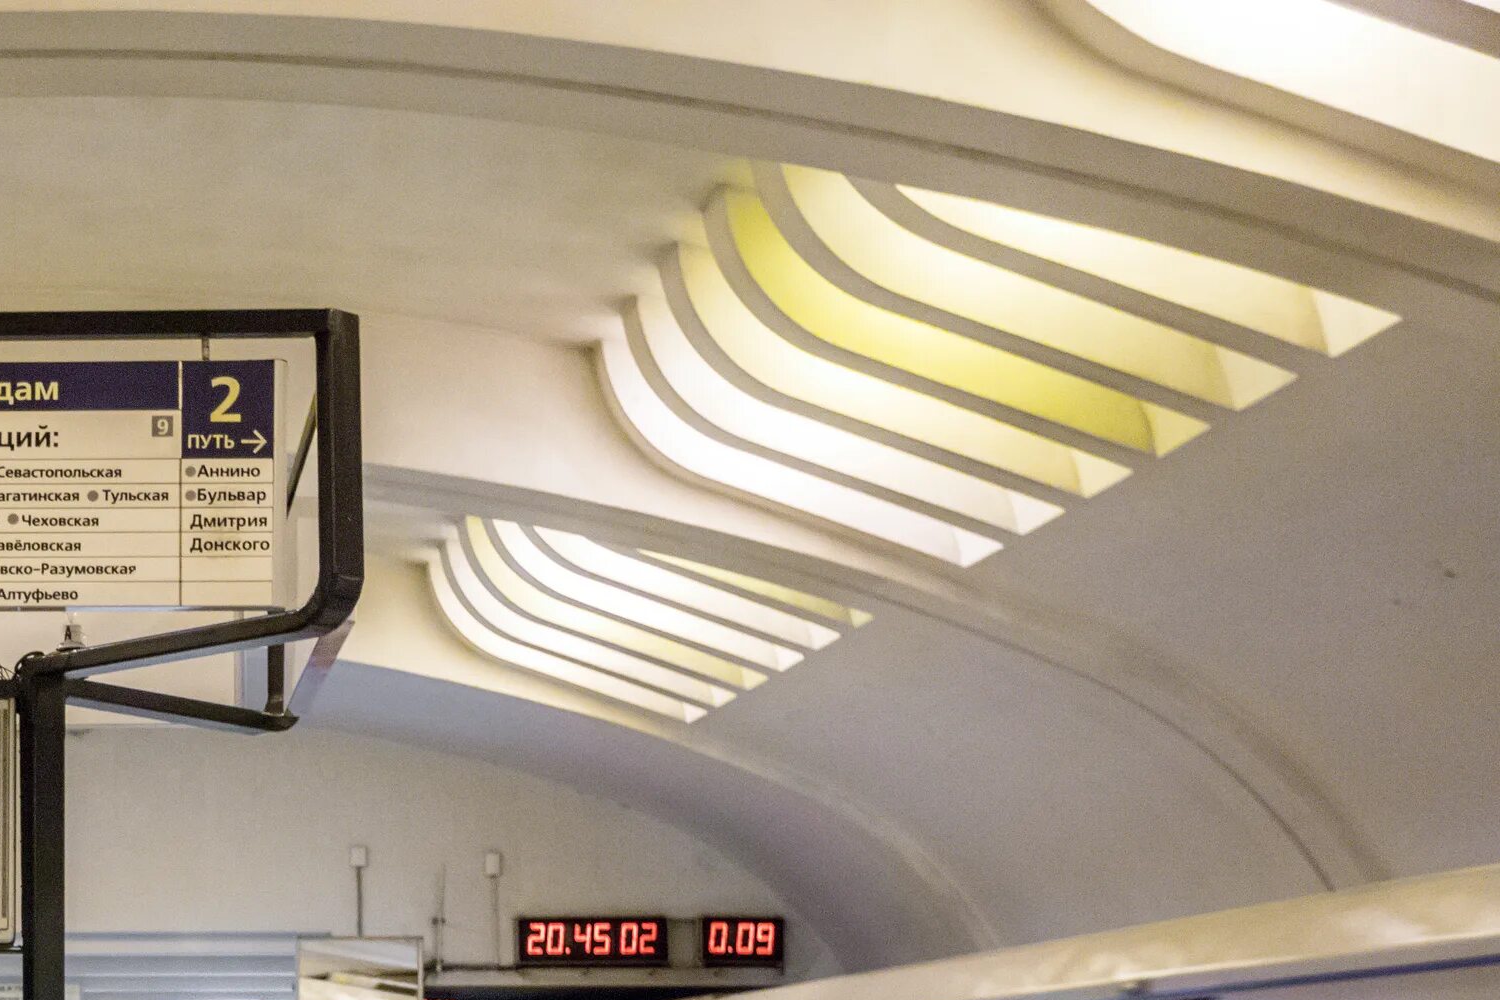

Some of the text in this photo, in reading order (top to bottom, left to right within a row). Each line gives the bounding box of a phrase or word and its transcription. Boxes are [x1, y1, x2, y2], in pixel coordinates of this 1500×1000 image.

[209, 376, 242, 423] 2
[157, 419, 169, 436] 9
[187, 433, 235, 450] ПУТЬ
[197, 464, 261, 478] Аннино
[102, 489, 169, 505] Тульская
[197, 488, 267, 505] Бульвар
[21, 514, 99, 527] Чеховская
[189, 513, 268, 531] Дмитрия
[189, 537, 270, 553] Донского
[526, 922, 658, 956] 20.45 02
[708, 921, 776, 956] 0.09
